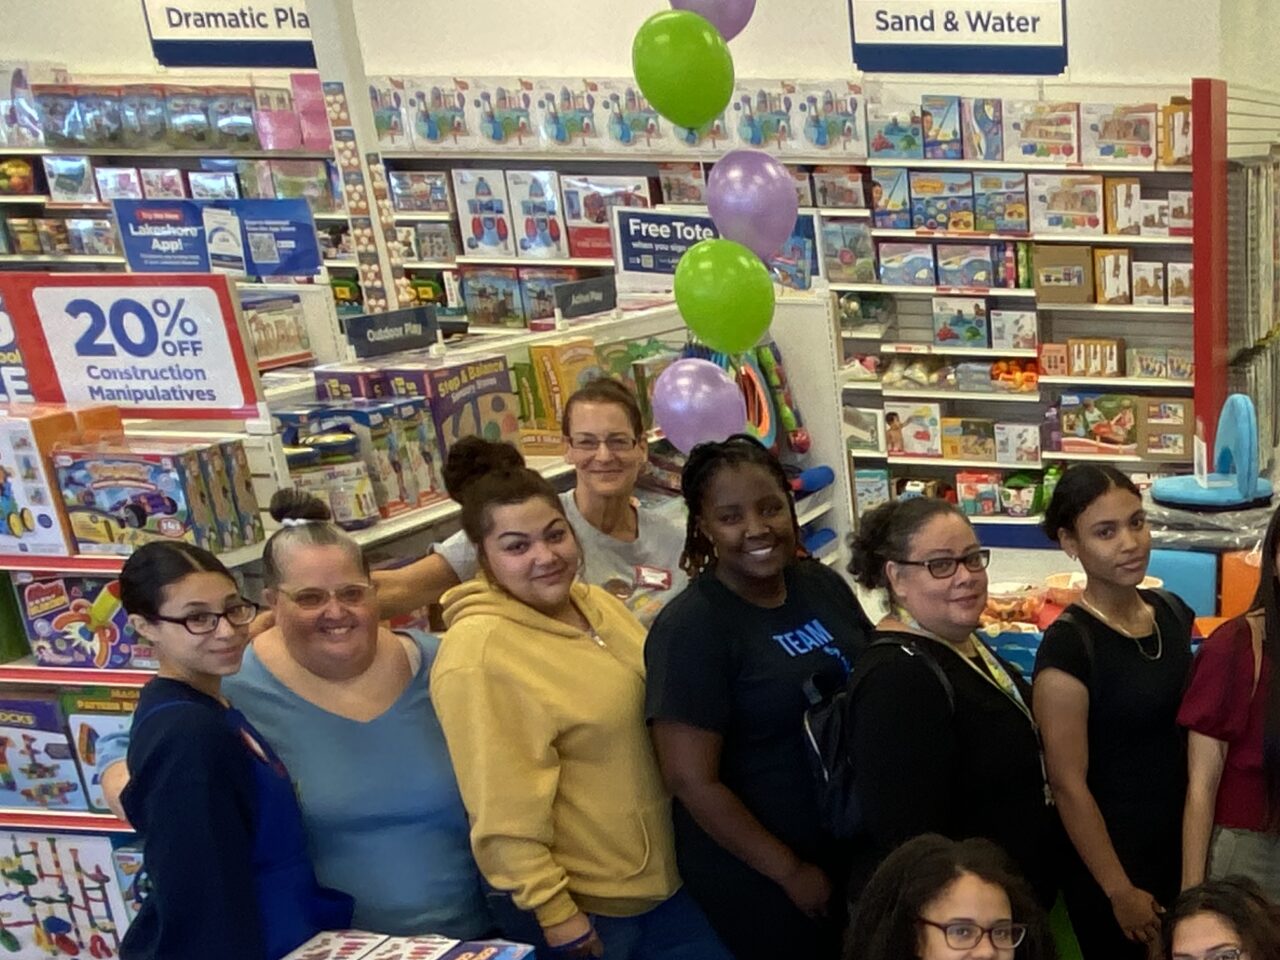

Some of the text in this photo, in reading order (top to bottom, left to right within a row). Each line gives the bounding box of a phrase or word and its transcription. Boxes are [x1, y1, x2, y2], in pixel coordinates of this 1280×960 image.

[166, 7, 310, 28] Dramatic Pla
[876, 10, 1040, 33] Sand & Water
[128, 223, 198, 237] Lakeshore
[628, 218, 714, 241] Free Tote
[151, 238, 183, 252] App!
[631, 240, 654, 250] when
[655, 243, 669, 252] you
[64, 298, 198, 358] 20%
[366, 322, 422, 342] Outdoor Play
[0, 351, 21, 364] ool
[162, 341, 203, 357] OFF
[87, 365, 207, 381] Construction
[89, 385, 217, 404] Manipulatives
[438, 377, 460, 398] Step
[773, 619, 834, 657] TEAM
[111, 689, 139, 698] MAG
[0, 711, 33, 725] OCKS
